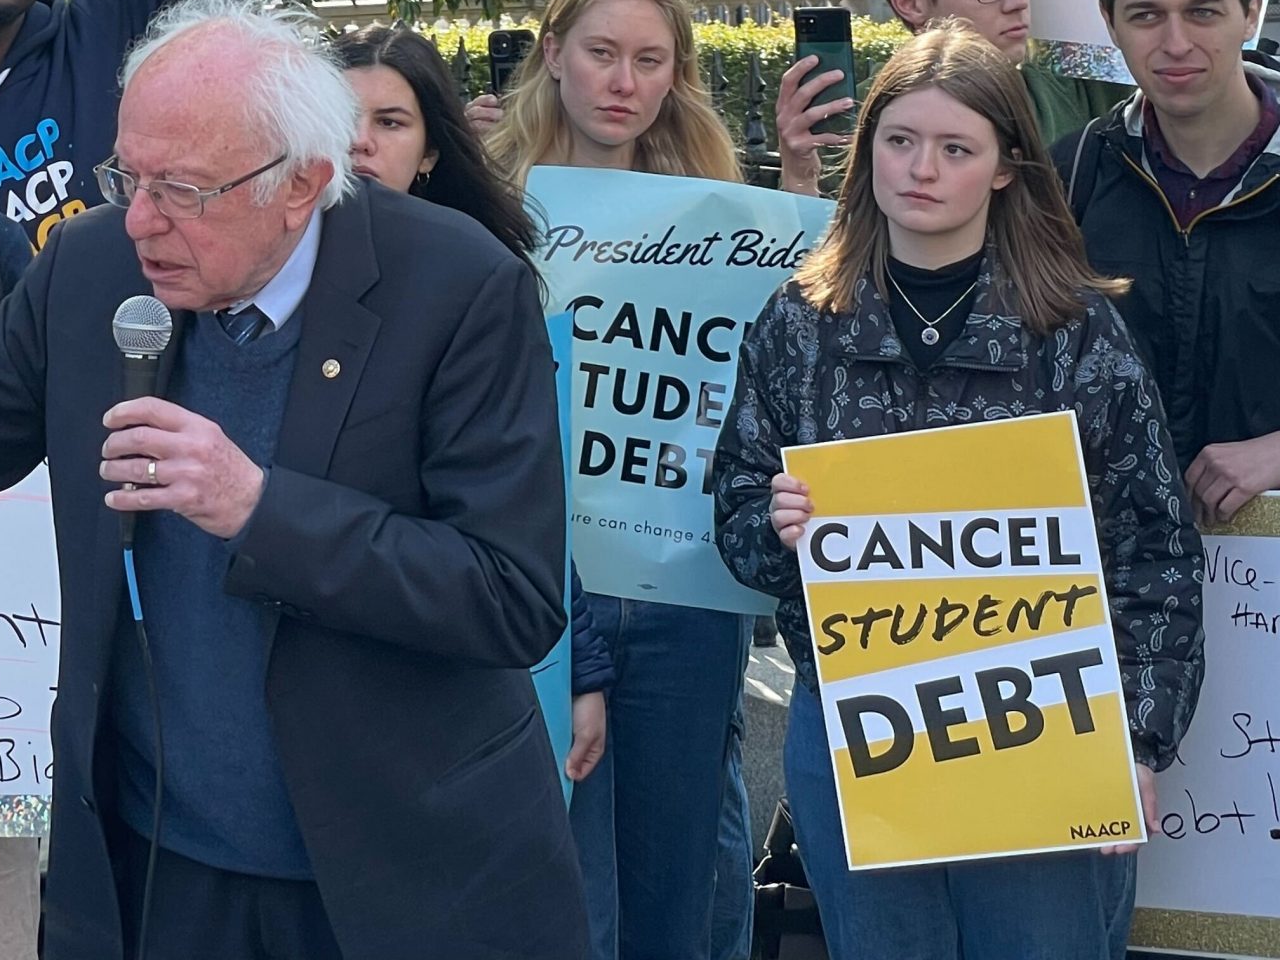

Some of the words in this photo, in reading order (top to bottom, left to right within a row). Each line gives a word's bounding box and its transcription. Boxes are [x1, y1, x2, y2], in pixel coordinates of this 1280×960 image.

[6, 160, 74, 224] ACP
[544, 224, 723, 266] President
[725, 228, 810, 269] Bide
[565, 294, 752, 363] CANC
[579, 361, 727, 428] TUDE
[598, 516, 627, 531] can
[633, 519, 694, 543] change
[809, 516, 1081, 573] CANCEL
[817, 583, 1098, 655] STUDENT
[835, 647, 1103, 779] DEBT
[1069, 820, 1131, 841] NAACP
